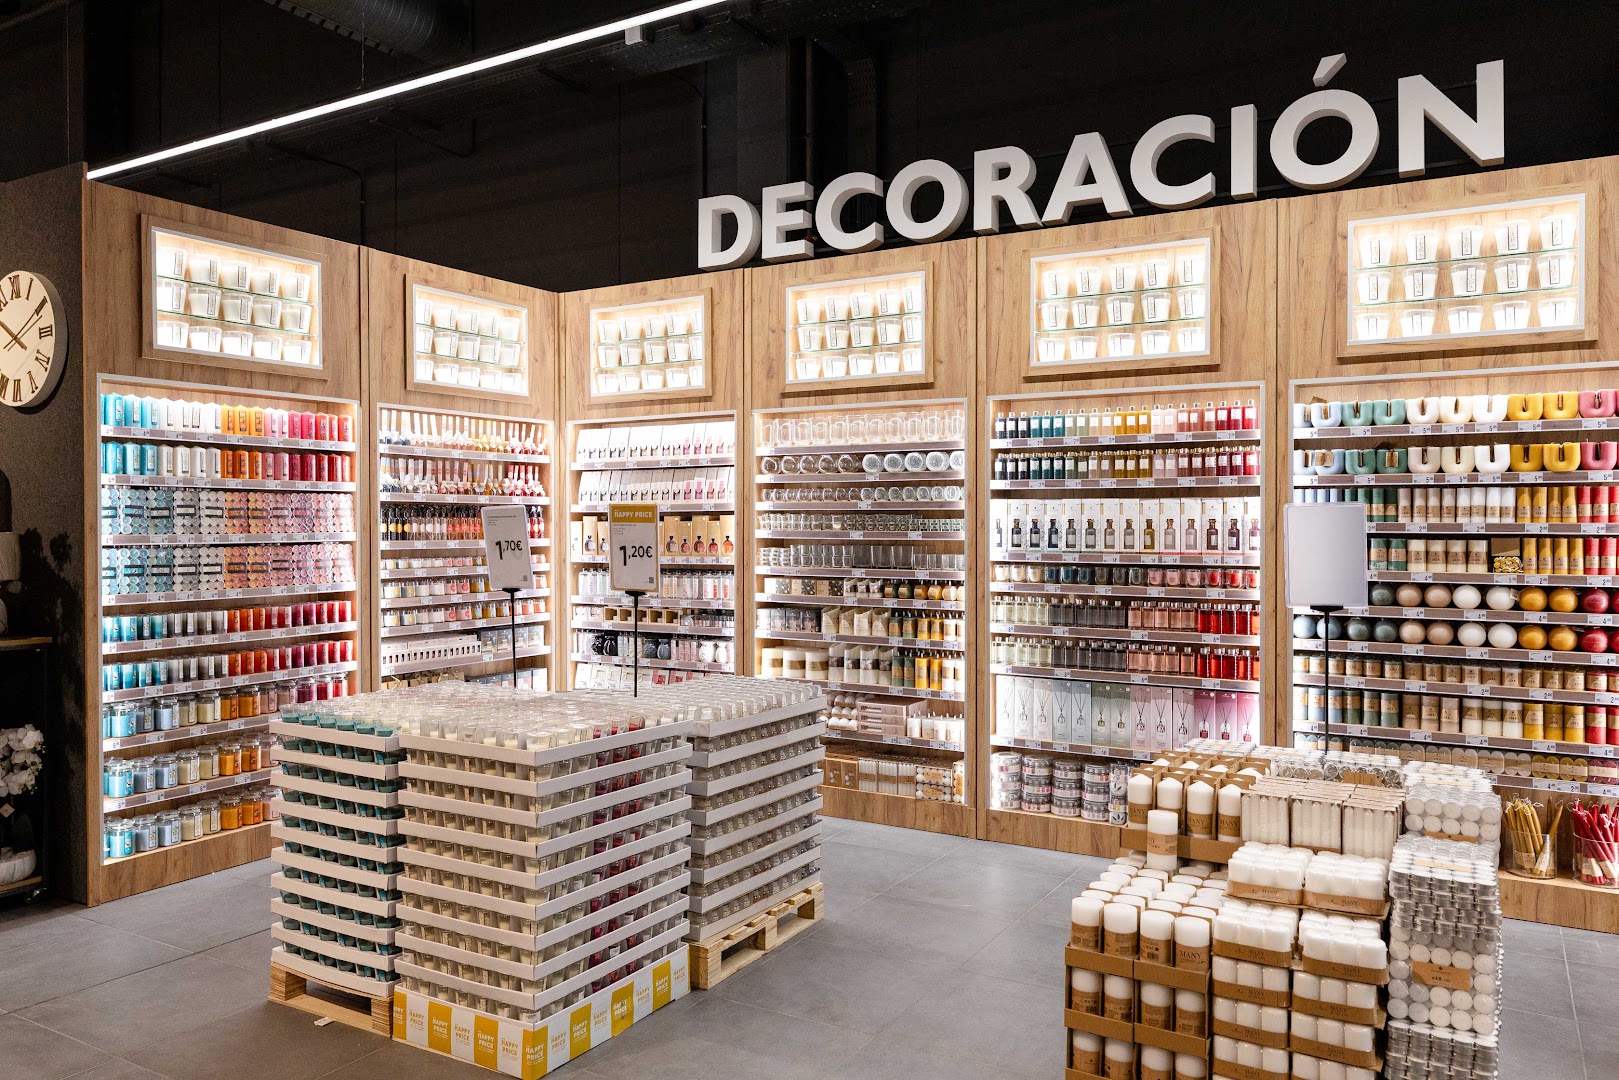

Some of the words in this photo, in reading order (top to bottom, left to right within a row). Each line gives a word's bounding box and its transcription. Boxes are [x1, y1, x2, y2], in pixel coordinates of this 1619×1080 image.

[698, 53, 1504, 271] DECORACIÓN
[495, 540, 522, 560] 1,70€
[619, 545, 653, 566] 1,20€
[1180, 949, 1202, 959] MANY
[432, 1018, 448, 1028] HAPPY
[572, 1020, 587, 1032] HAPPY
[433, 1025, 448, 1035] PRICE
[454, 1024, 471, 1034] HAPPY
[573, 1027, 587, 1038] PRICE
[455, 1032, 470, 1041] PRICE
[477, 1032, 495, 1041] HAPPY
[551, 1032, 566, 1043] HAPPY
[478, 1039, 493, 1049] PRICE
[501, 1039, 519, 1050] HAPPY
[525, 1043, 544, 1054] HAPPY
[552, 1039, 566, 1050] PRICE
[502, 1047, 517, 1057] PRICE
[526, 1052, 544, 1061] PRICE
